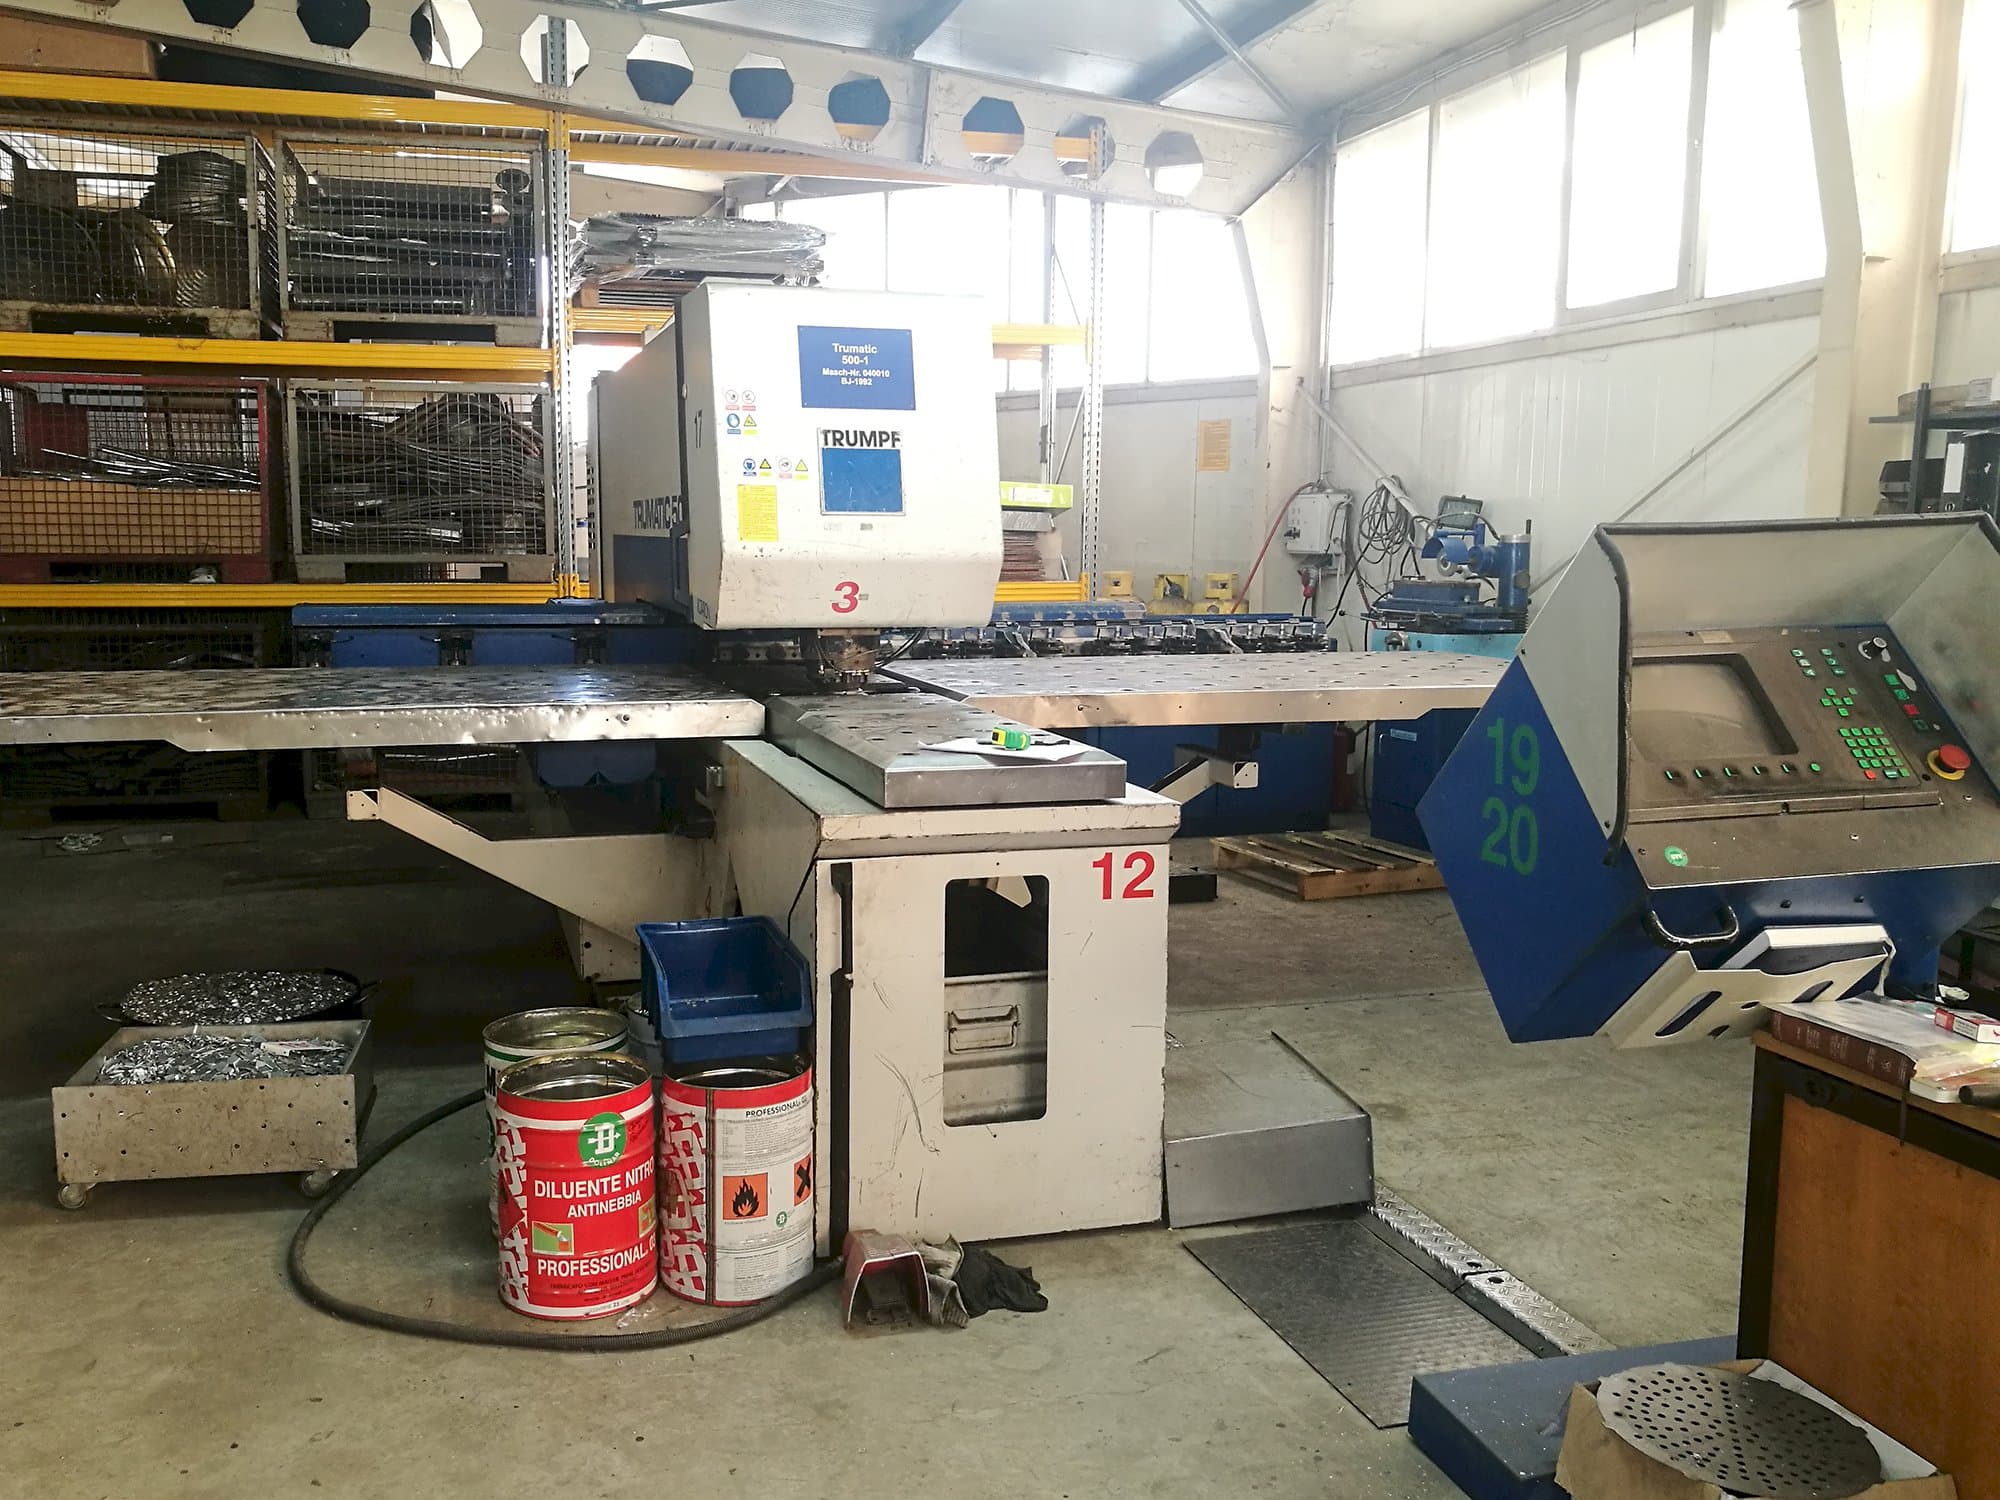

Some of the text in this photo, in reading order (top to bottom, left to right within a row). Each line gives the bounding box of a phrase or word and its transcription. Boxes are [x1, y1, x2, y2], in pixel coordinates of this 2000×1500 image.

[832, 343, 877, 353] Trumatic
[842, 355, 868, 365] 500-1
[822, 429, 901, 448] TRUMPF
[633, 497, 671, 529] TRUMATIC
[831, 581, 859, 613] 3
[1487, 717, 1540, 796] 19
[1480, 797, 1539, 876] 20
[1092, 851, 1155, 900] 12
[534, 1156, 655, 1199] DILUENTE NITRO
[567, 1190, 642, 1218] ANTINEBBIA
